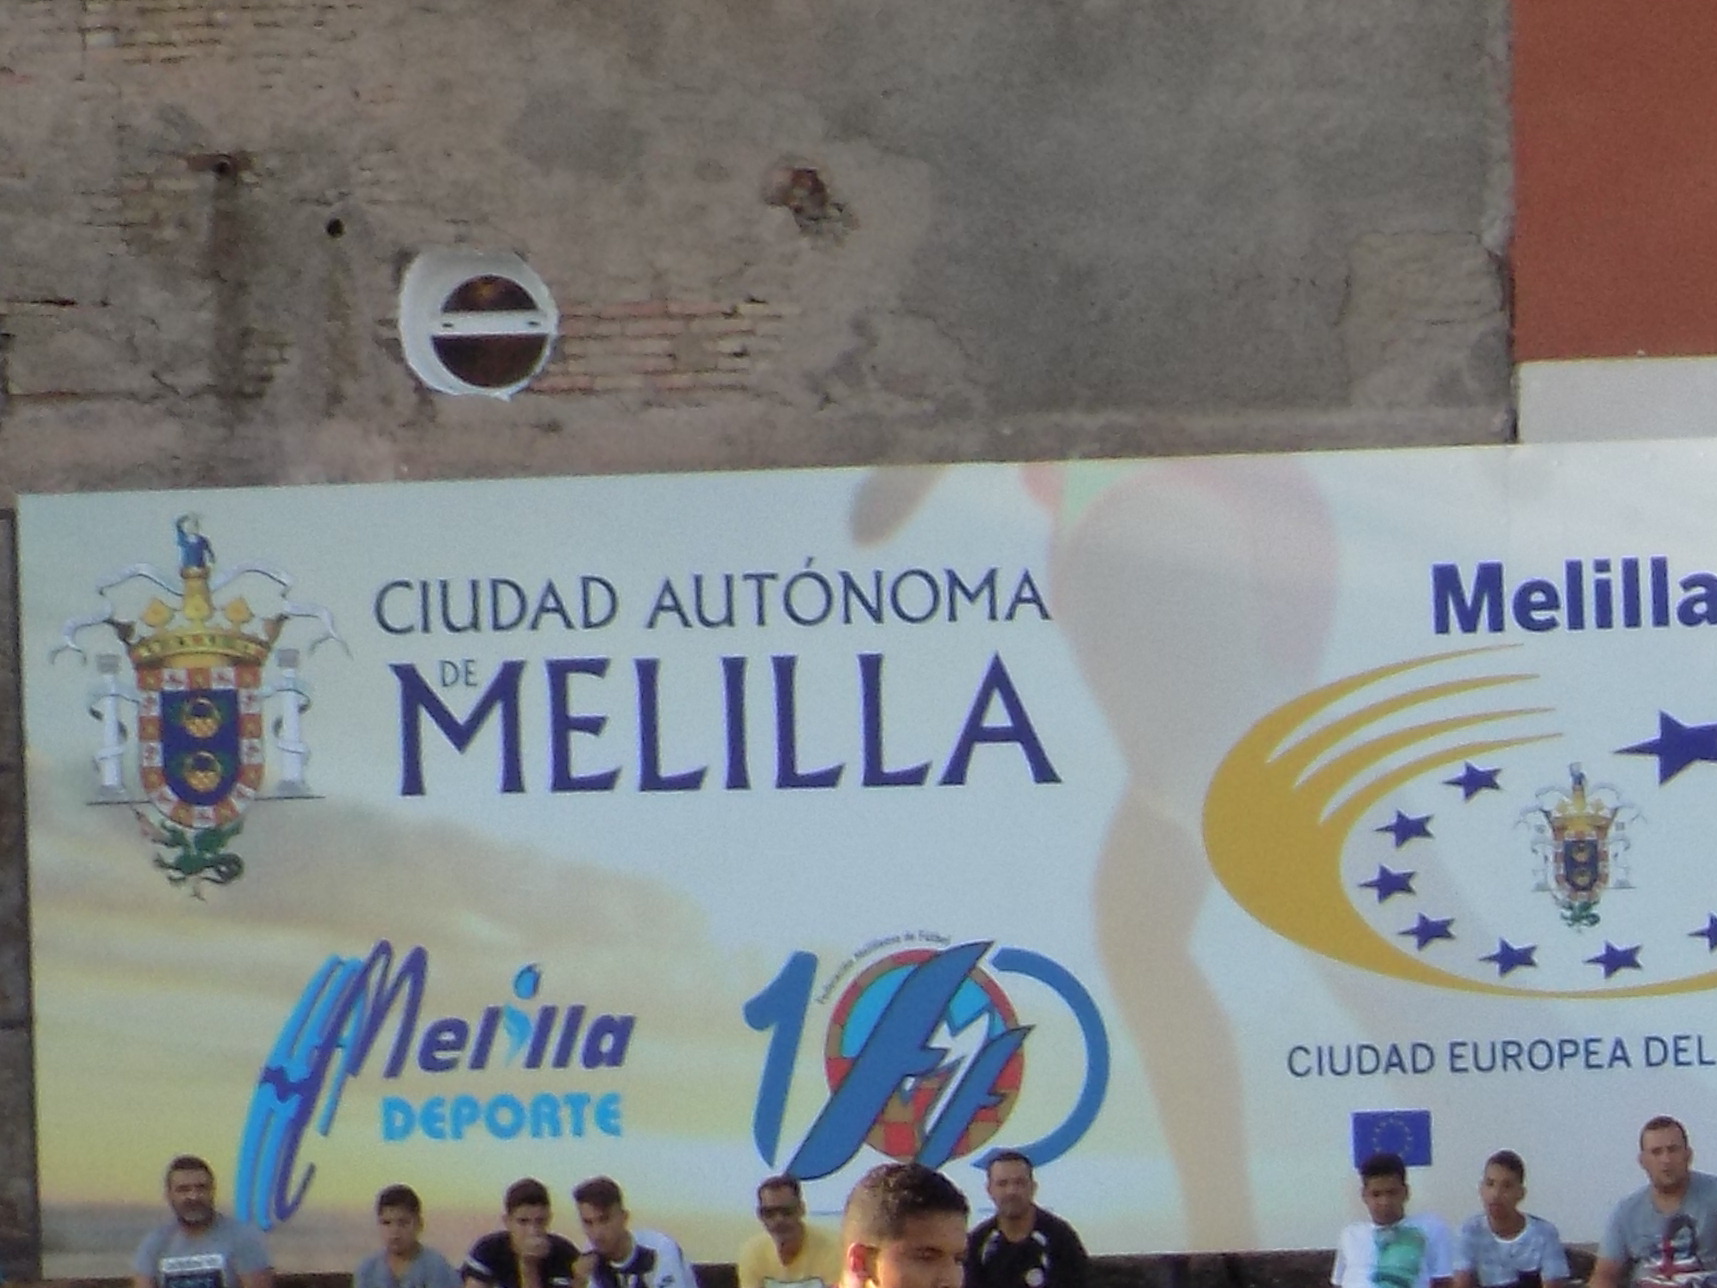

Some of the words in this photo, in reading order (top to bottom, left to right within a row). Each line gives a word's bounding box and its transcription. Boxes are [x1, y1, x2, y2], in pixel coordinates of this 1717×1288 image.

[374, 575, 619, 635] CIUDAD
[645, 556, 1053, 631] AUTÓNOMA
[439, 658, 478, 688] DE
[388, 650, 1063, 797] MELILLA
[1286, 1041, 1436, 1078] CIUDAD
[1448, 1036, 1631, 1074] EUROPEA
[1644, 1033, 1717, 1068] DEL
[380, 1091, 624, 1142] DEPORTE
